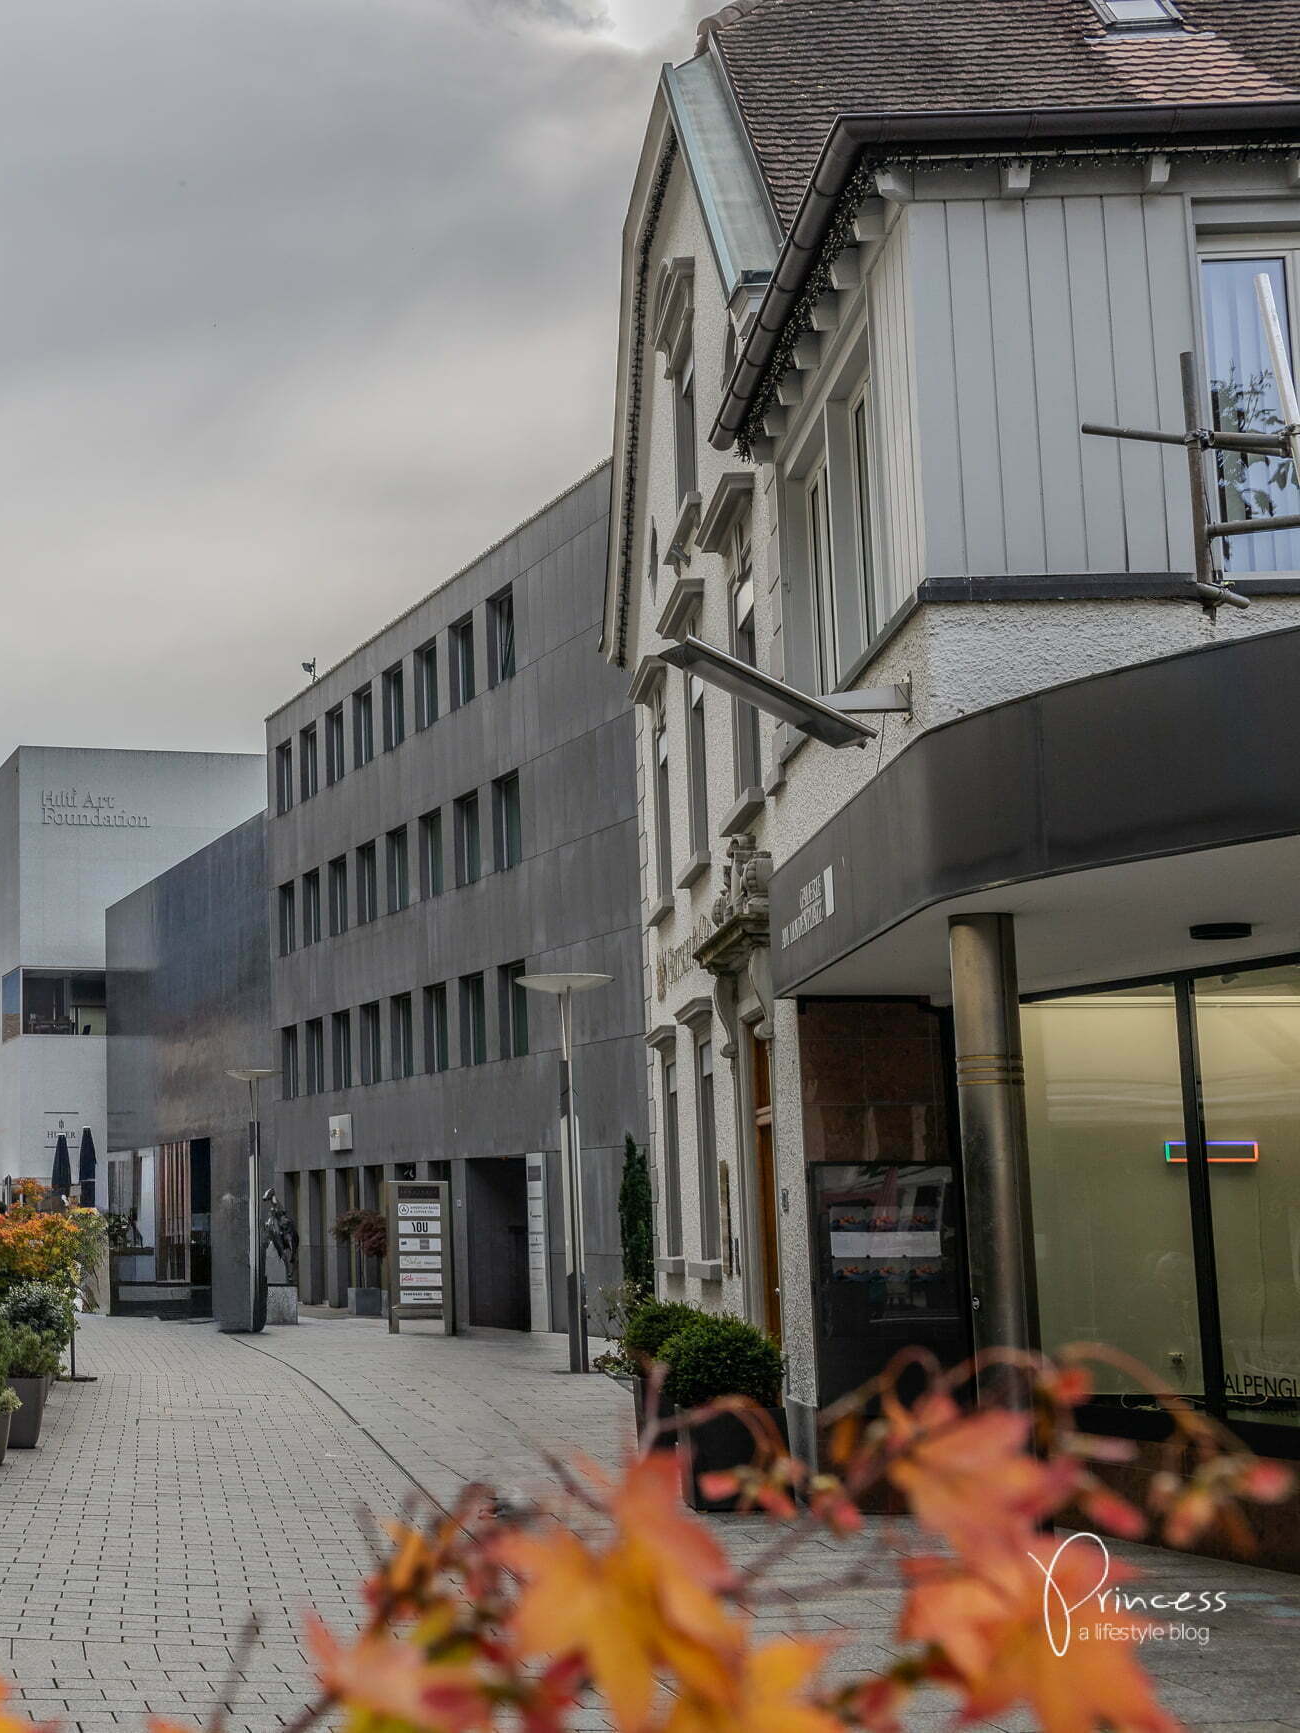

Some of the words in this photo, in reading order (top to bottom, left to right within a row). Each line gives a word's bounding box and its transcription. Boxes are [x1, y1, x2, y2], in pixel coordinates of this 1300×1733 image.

[40, 788, 77, 808] Hilti
[82, 791, 116, 808] Art
[41, 807, 151, 828] Foundation
[799, 874, 822, 911] GALERIE
[46, 1130, 76, 1139] HER
